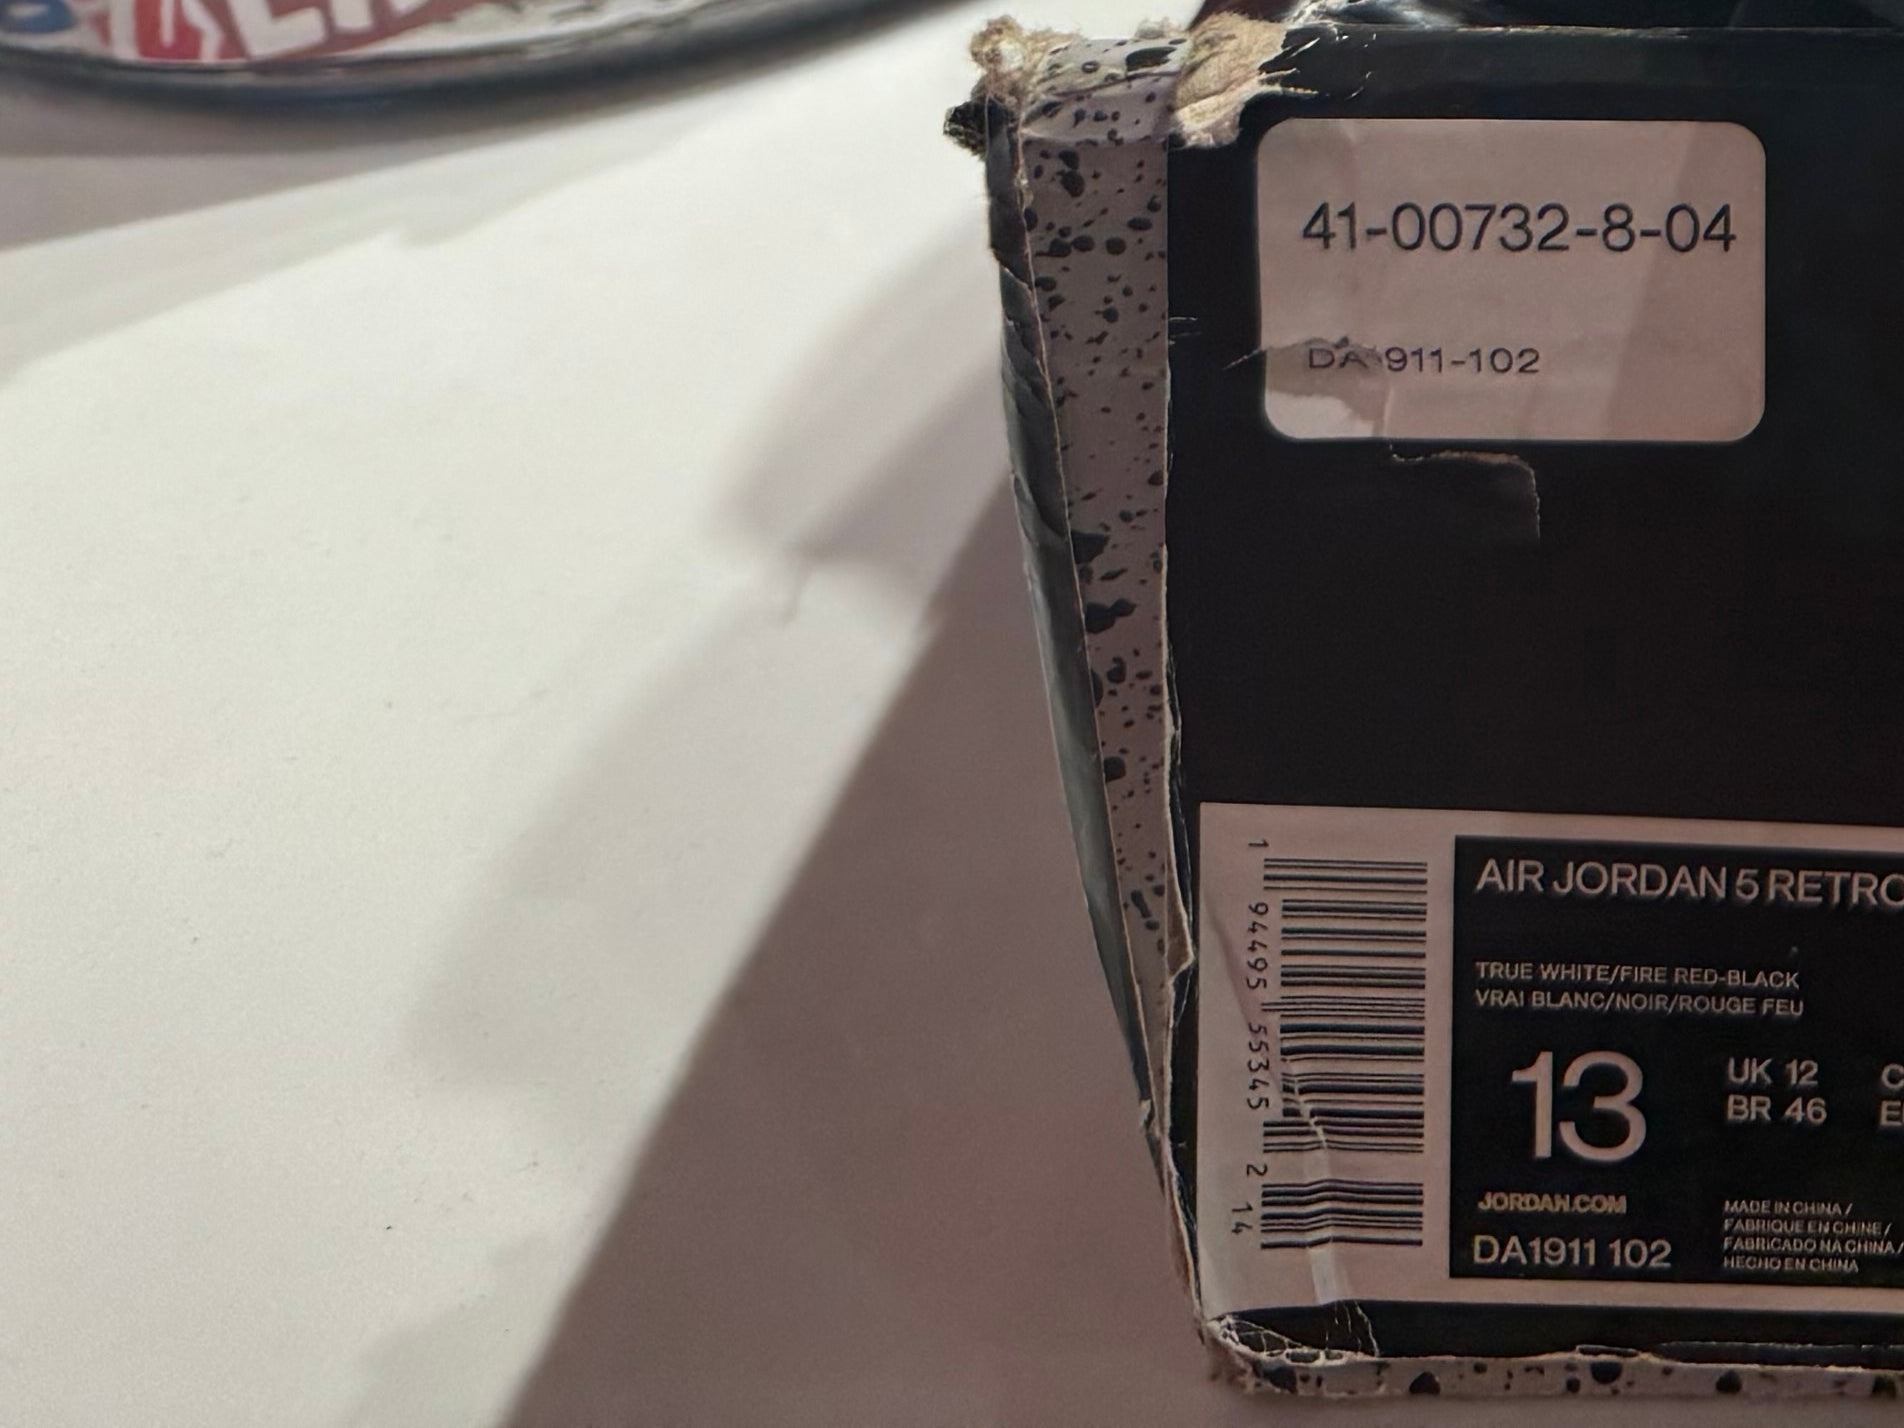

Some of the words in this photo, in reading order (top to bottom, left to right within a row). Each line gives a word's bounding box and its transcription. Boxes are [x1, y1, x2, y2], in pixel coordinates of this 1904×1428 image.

[1302, 201, 1738, 253] 41-00732-8-04
[1307, 345, 1541, 375] DA911-102
[1474, 858, 1545, 894] AIR
[1552, 860, 1728, 902] JORDAN
[1735, 868, 1760, 901] 5
[1475, 961, 1534, 981] TRUE
[1539, 962, 1667, 986] WHITE/FIRE
[1674, 967, 1801, 990] RED-BLACK
[1474, 989, 1525, 1009] VRAI
[1531, 990, 1757, 1015] BLANC/NOIR/ROUGE
[1762, 998, 1805, 1017] FEU
[1727, 1057, 1772, 1088] UK
[1784, 1059, 1820, 1089] 12
[1510, 1049, 1647, 1163] 13
[1726, 1095, 1772, 1124] BR
[1782, 1096, 1828, 1126] 46
[1477, 1190, 1627, 1215] JORDAN.COM
[1724, 1199, 1772, 1215] MADE
[1774, 1200, 1791, 1215] IN
[1792, 1201, 1843, 1216] CHINA
[1723, 1218, 1805, 1234] FABRIQUE
[1807, 1219, 1830, 1234] EN
[1472, 1233, 1598, 1268] DA1911
[1608, 1237, 1672, 1270] 102
[1722, 1236, 1817, 1253] FABRICADO
[1819, 1238, 1843, 1253] NA
[1844, 1239, 1896, 1255] CHINA
[1723, 1254, 1782, 1271] HECHO
[1784, 1256, 1806, 1271] EN
[1808, 1257, 1860, 1274] CHINA
